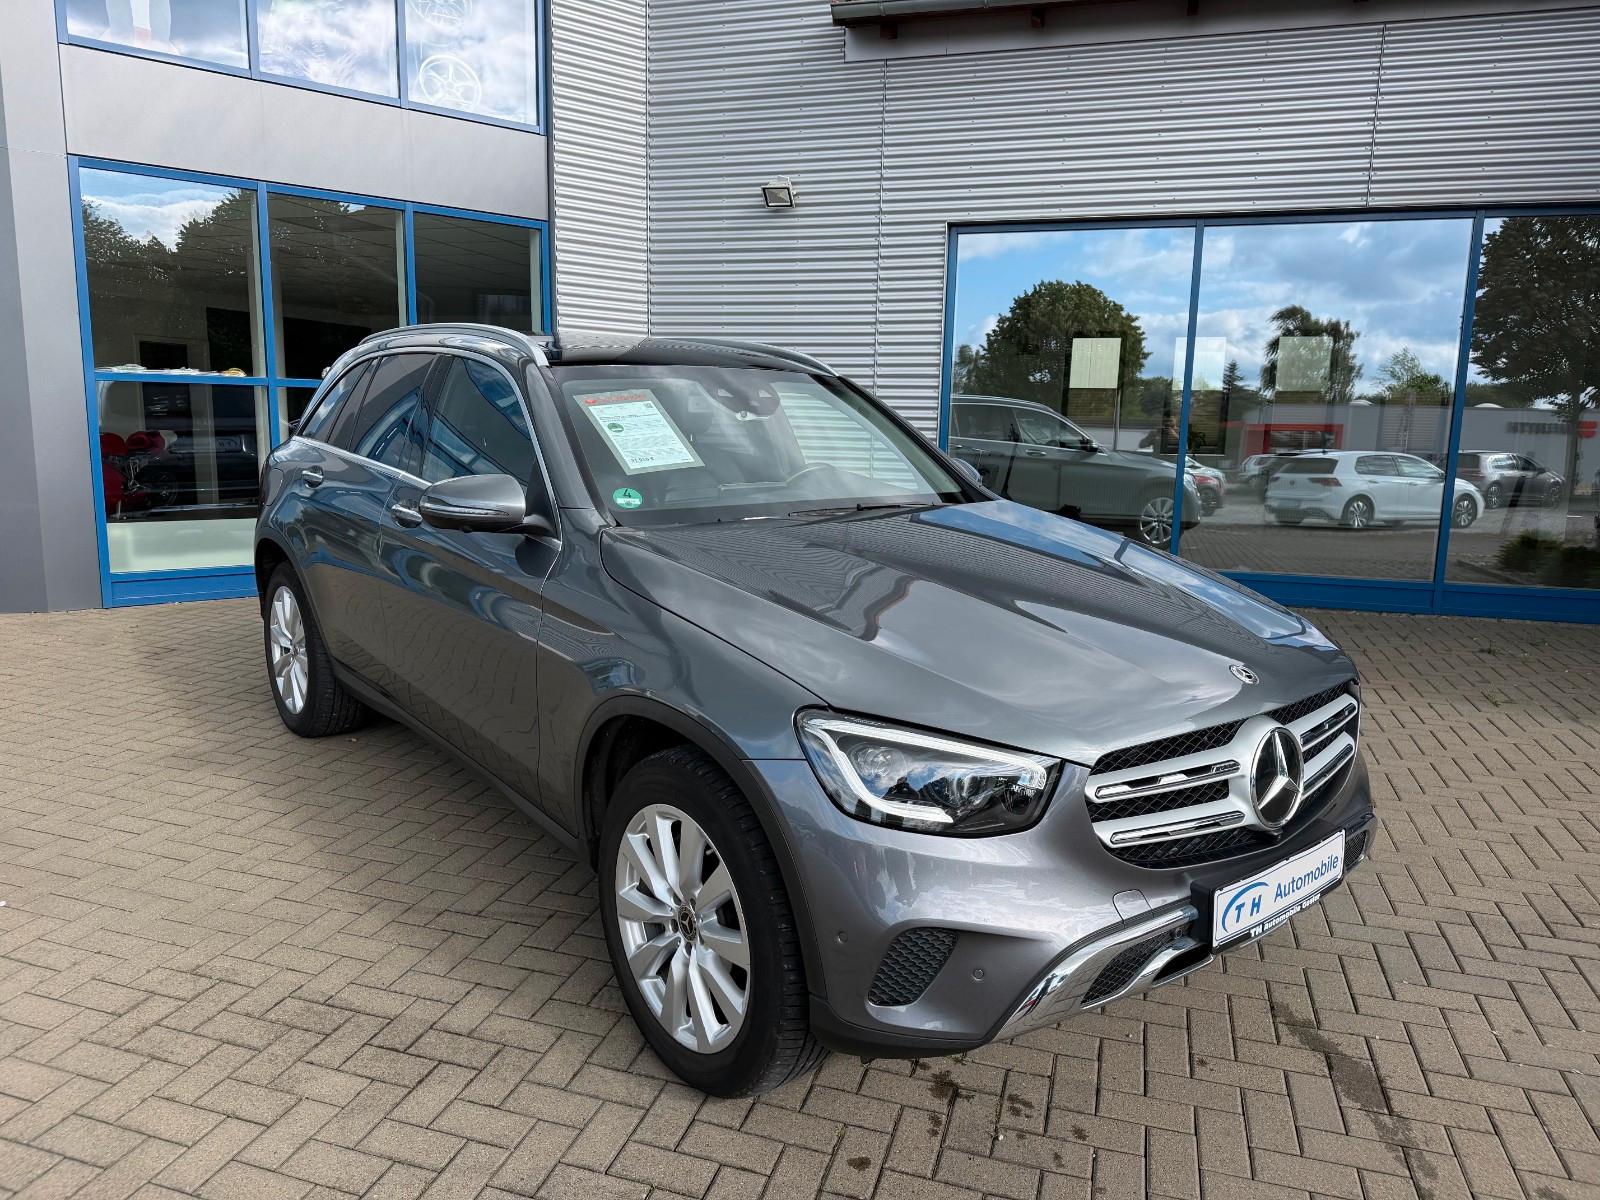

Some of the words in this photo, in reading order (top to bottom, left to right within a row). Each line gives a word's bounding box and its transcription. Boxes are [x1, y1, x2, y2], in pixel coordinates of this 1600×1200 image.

[623, 488, 631, 498] 4
[1274, 853, 1339, 903] Automobile
[1249, 924, 1263, 938] TH
[1263, 905, 1302, 931] Automobile
